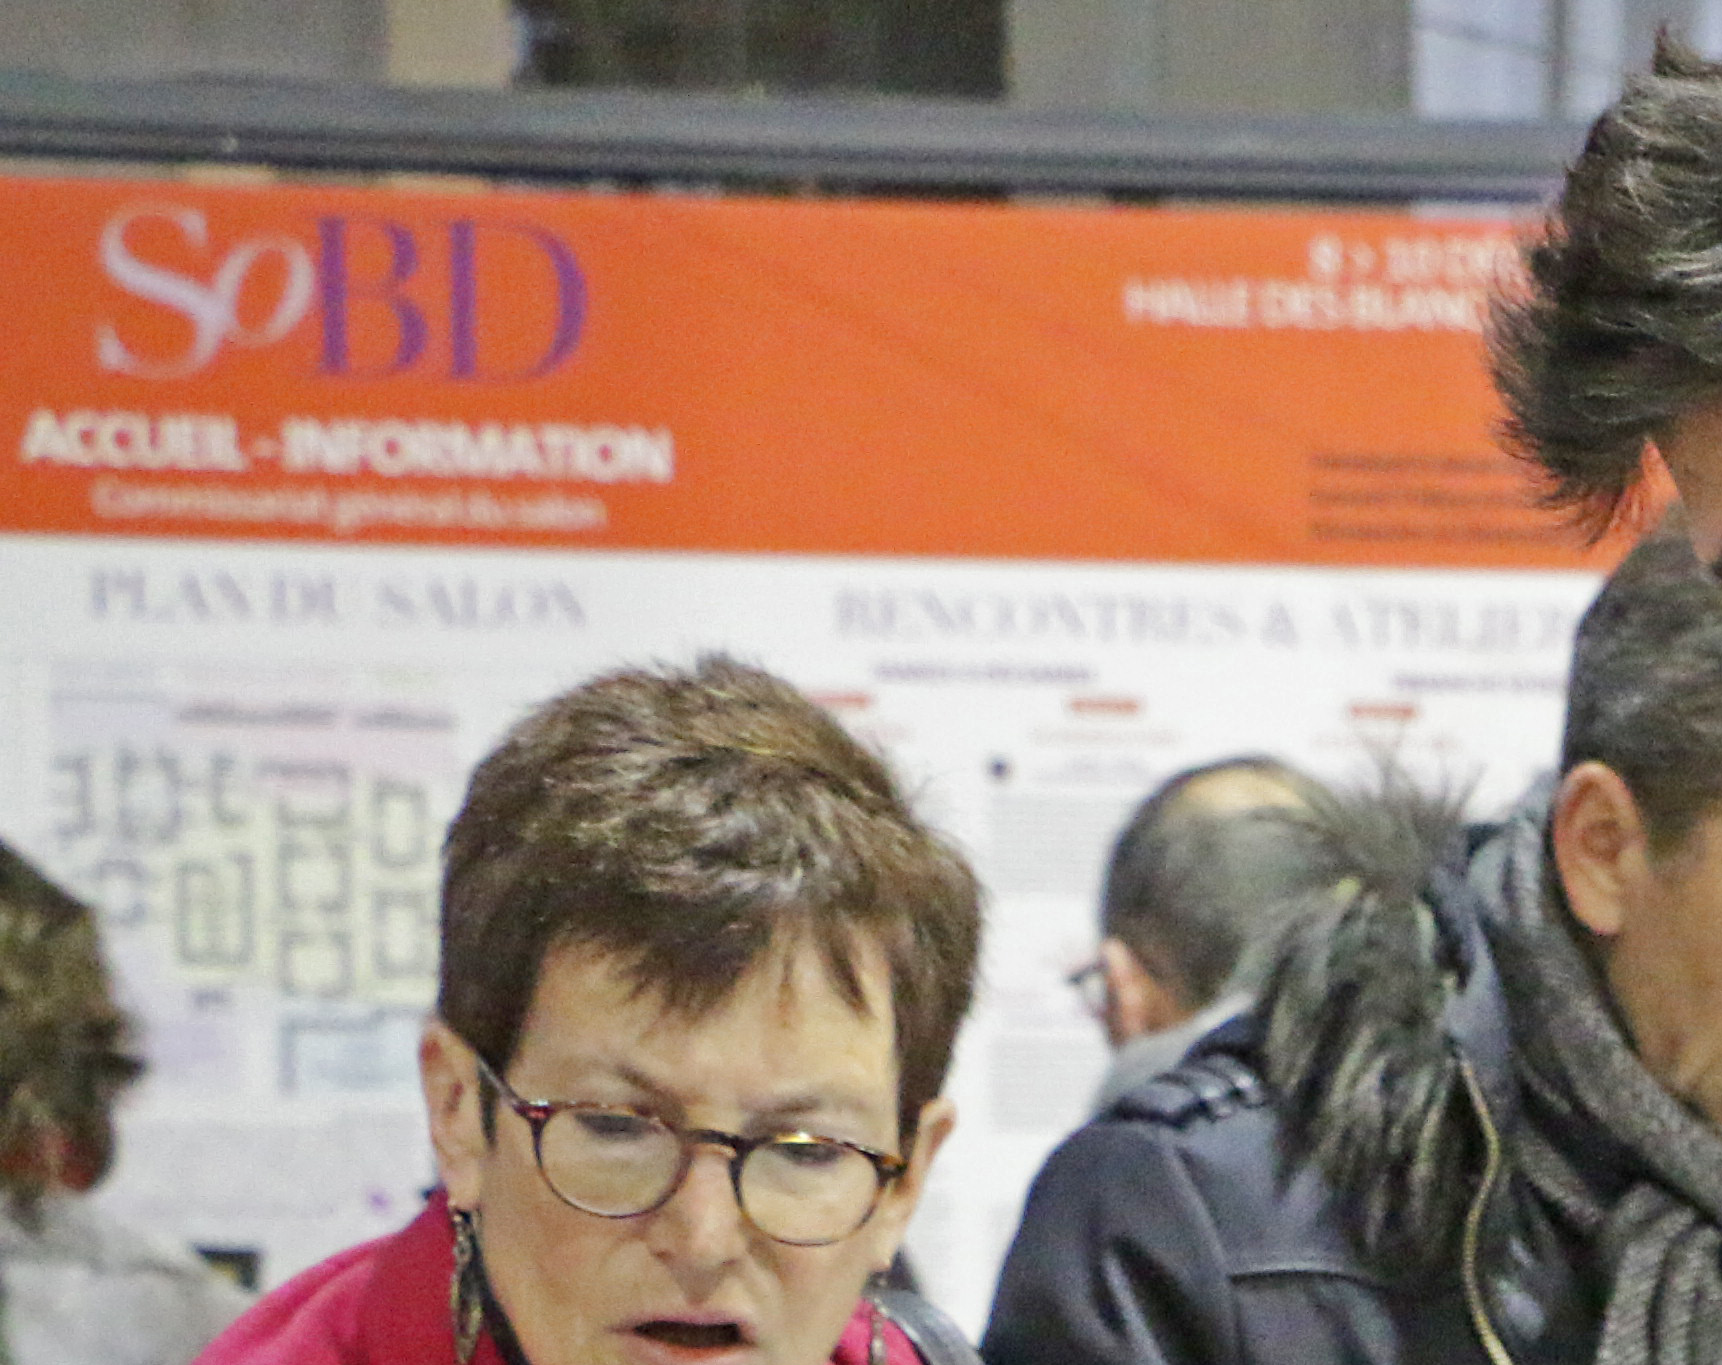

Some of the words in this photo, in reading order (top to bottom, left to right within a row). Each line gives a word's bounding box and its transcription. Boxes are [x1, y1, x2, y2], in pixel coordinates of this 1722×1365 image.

[94, 202, 590, 382] SoBD
[20, 411, 246, 471] ACCUEIL
[282, 416, 674, 482] INFORMATION
[90, 565, 252, 620] PLAN
[268, 567, 340, 624] DU
[374, 570, 590, 630] SALON
[837, 583, 1247, 645] RENCONTRES
